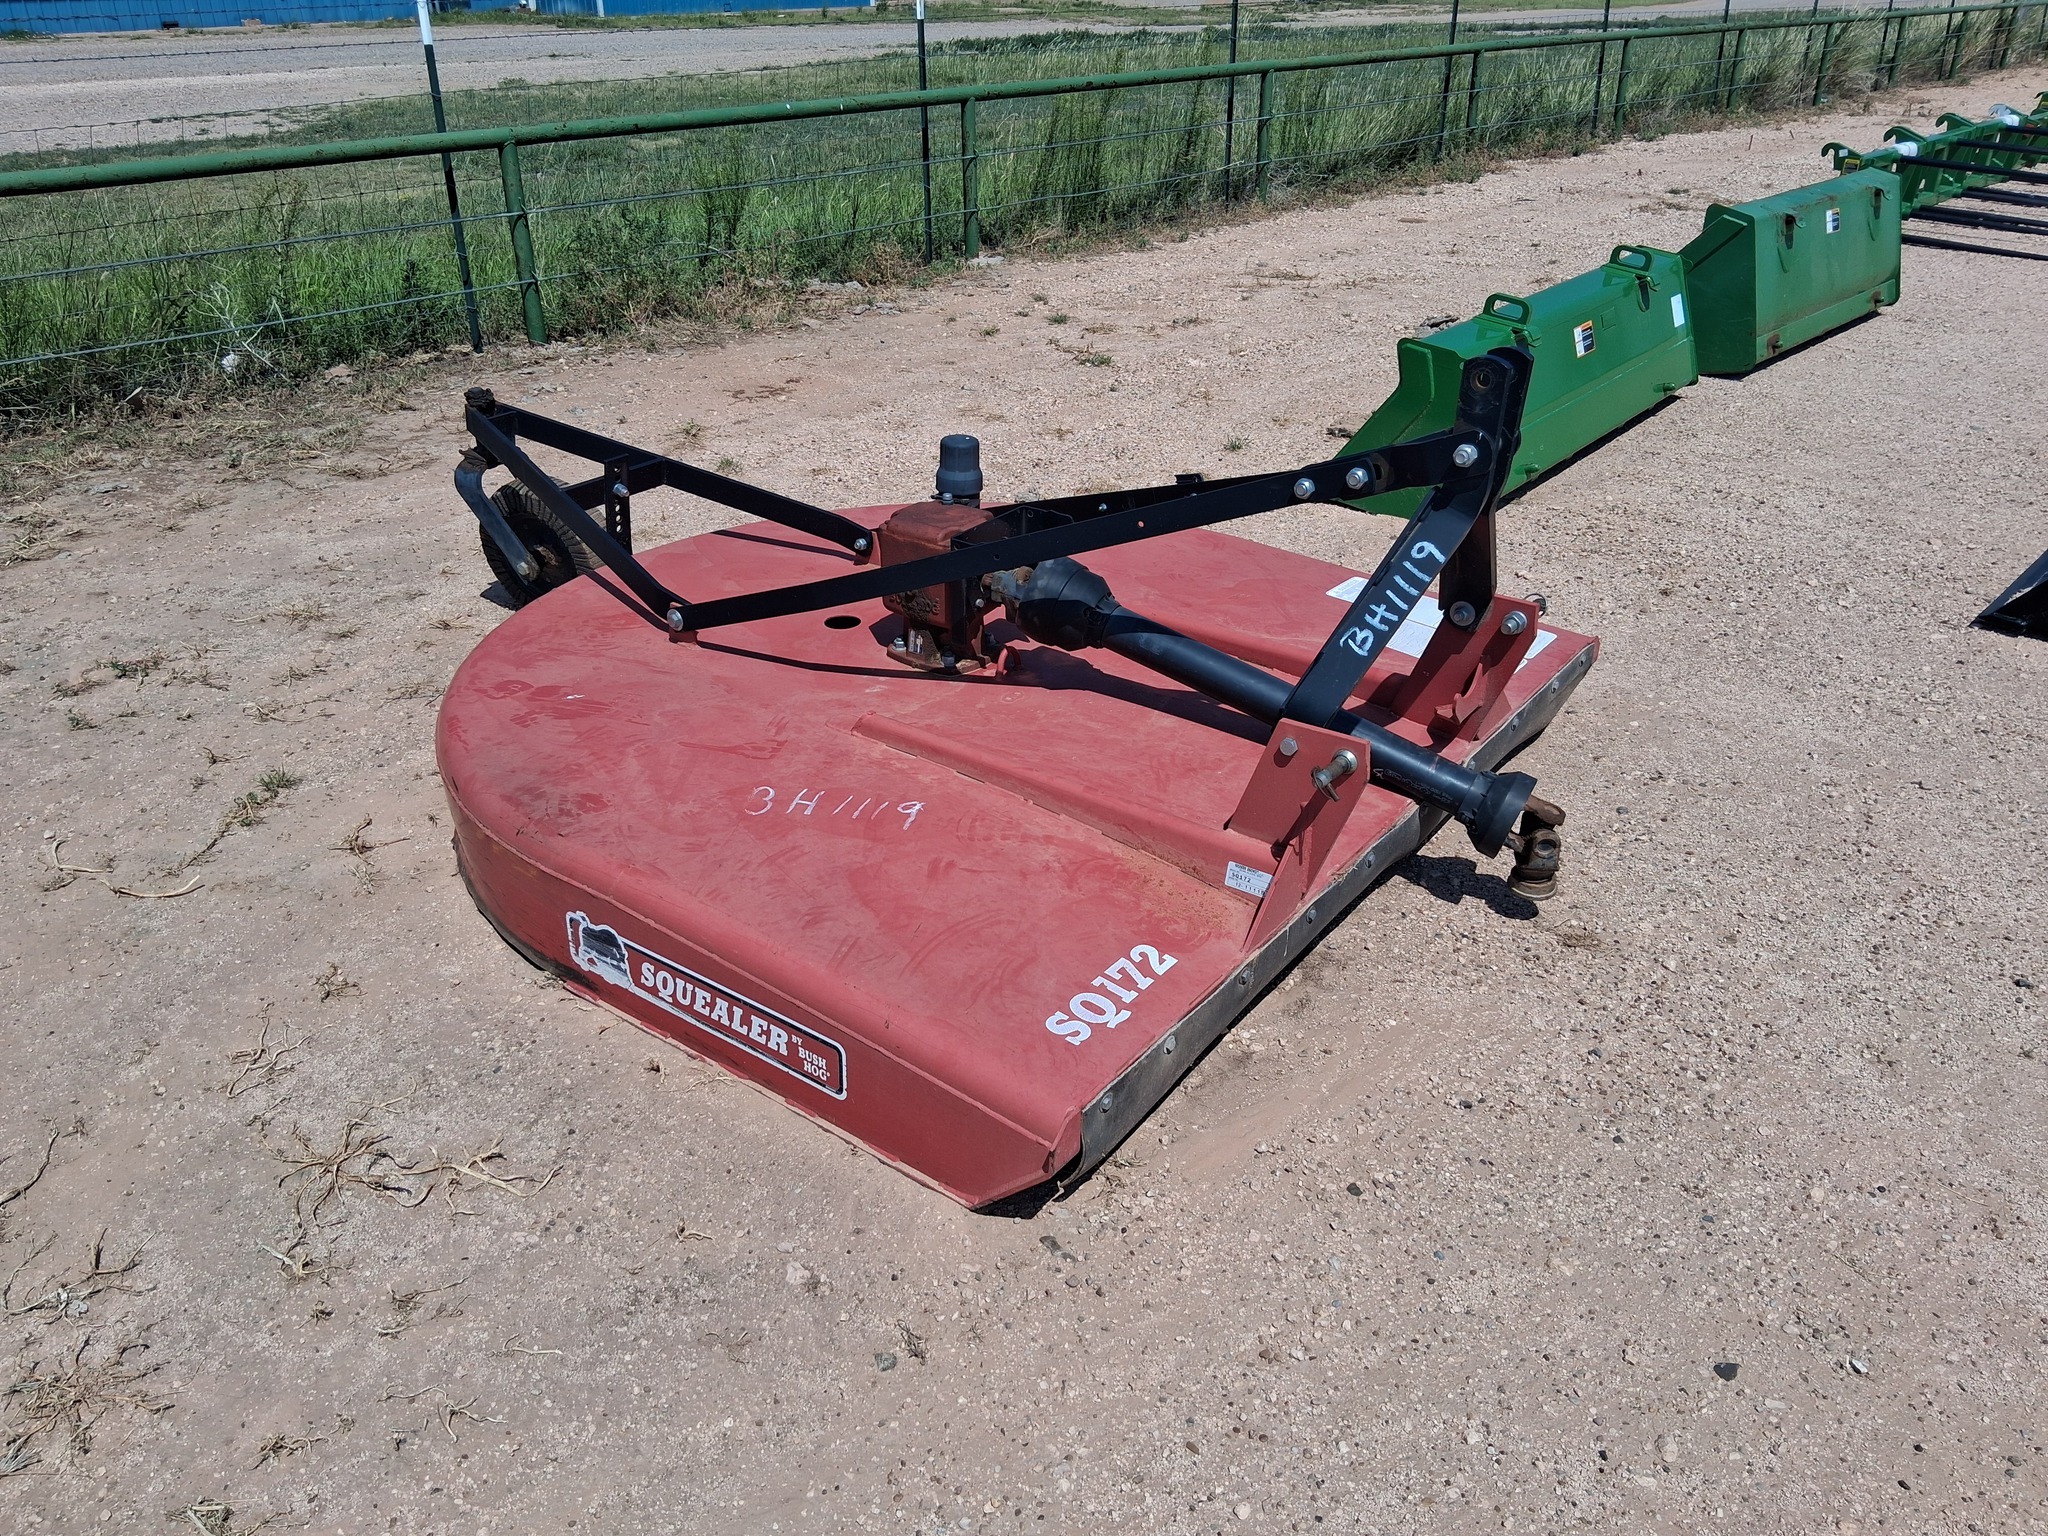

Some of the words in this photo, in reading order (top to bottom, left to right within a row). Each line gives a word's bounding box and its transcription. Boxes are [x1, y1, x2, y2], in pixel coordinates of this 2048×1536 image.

[1340, 541, 1446, 657] BH1119
[640, 962, 788, 1057] SQUEALER
[791, 1034, 802, 1045] BY
[1045, 944, 1179, 1046] SQ172
[798, 1046, 827, 1070] BUSH
